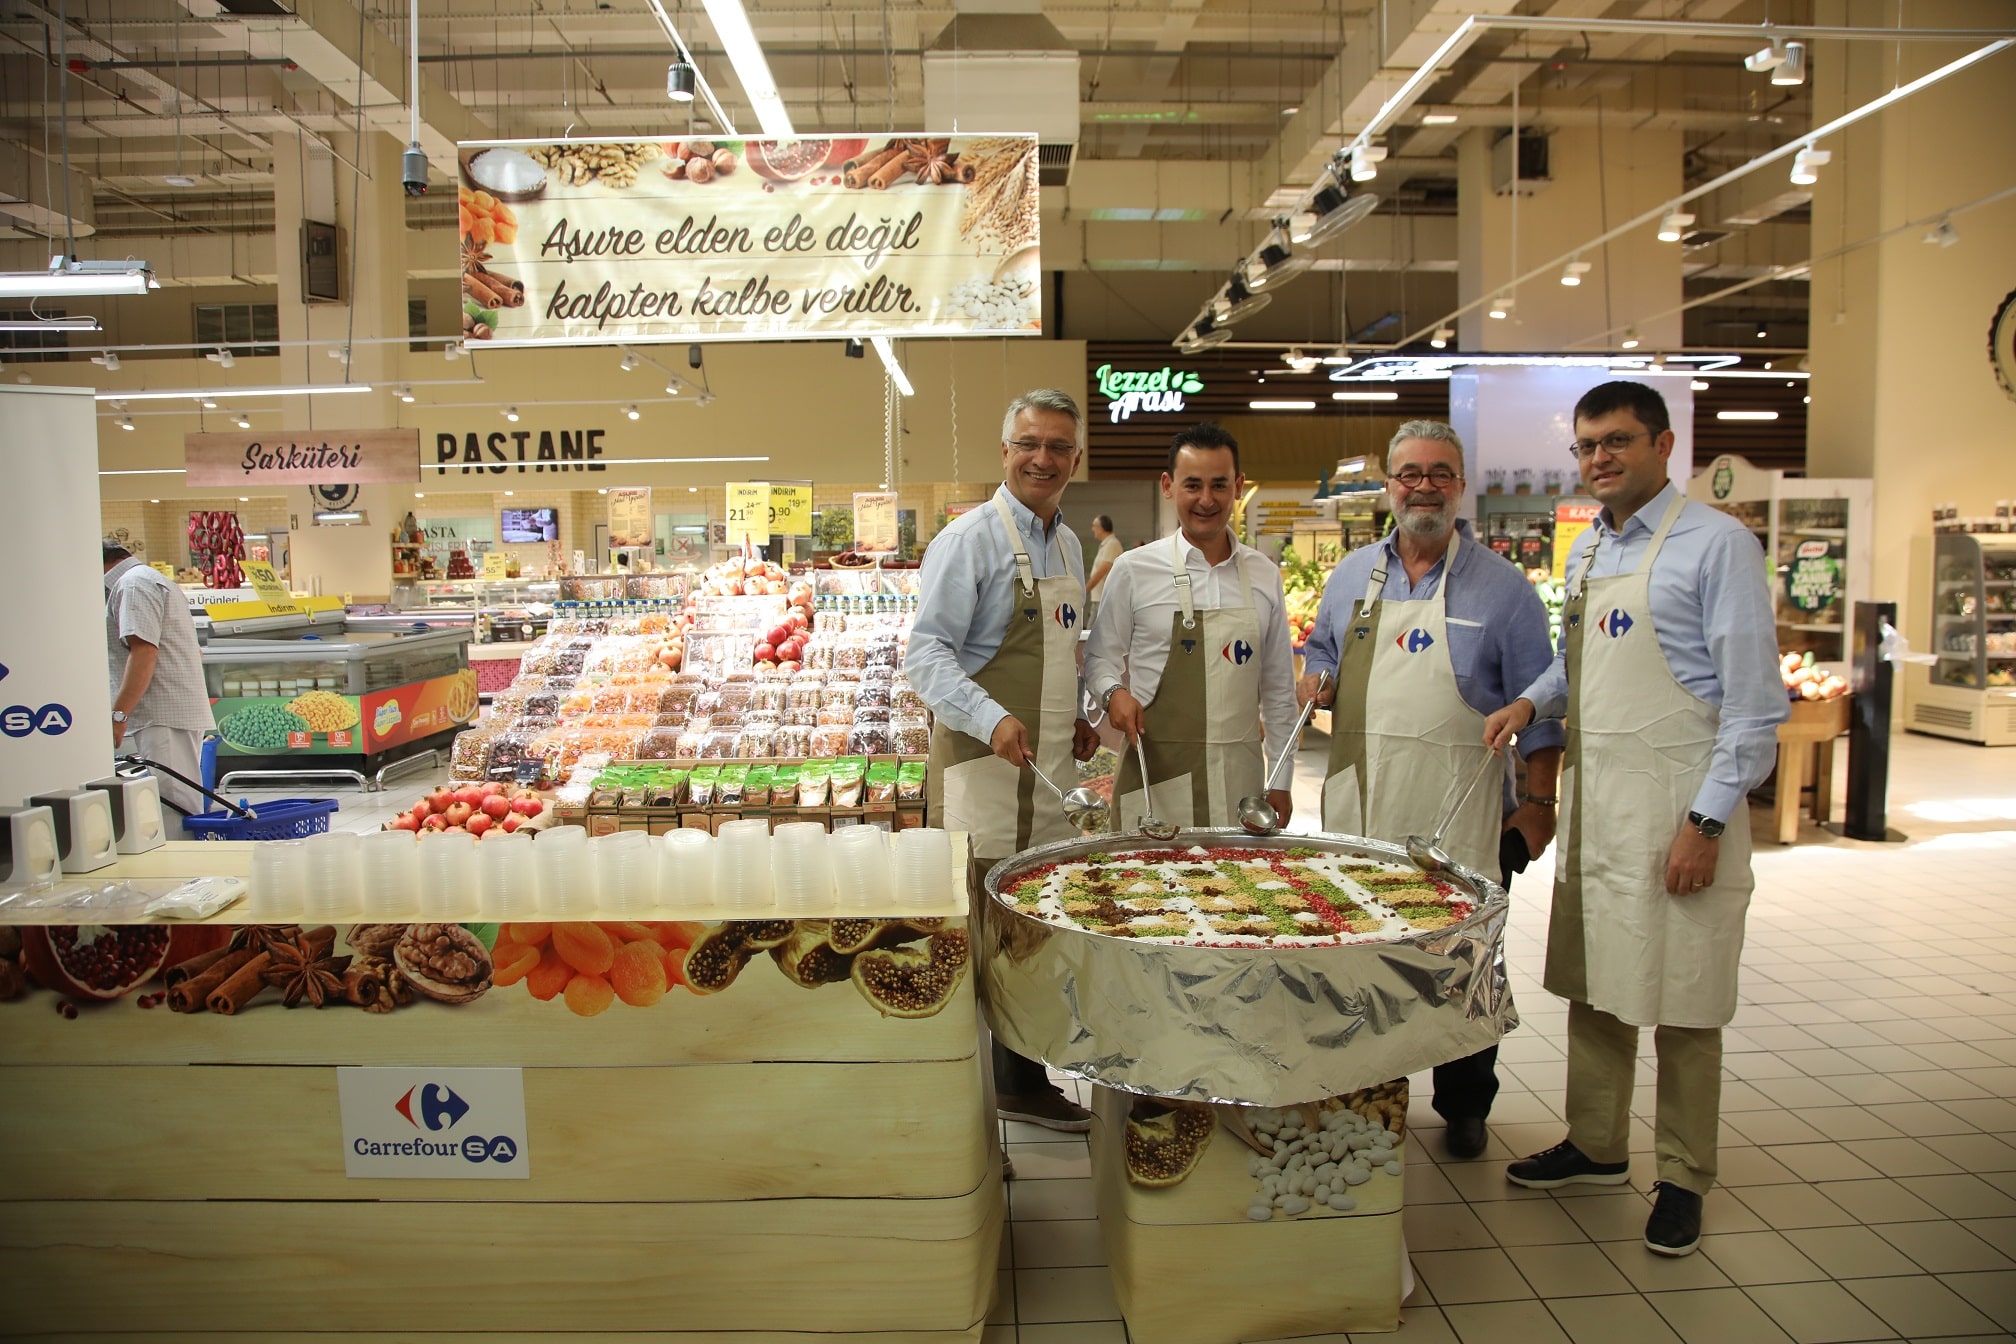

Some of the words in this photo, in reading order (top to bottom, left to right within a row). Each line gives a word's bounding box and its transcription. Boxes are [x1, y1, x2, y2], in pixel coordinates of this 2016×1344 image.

[541, 217, 646, 264] Aşure
[655, 214, 754, 255] elden
[763, 213, 817, 252] ele
[826, 211, 923, 270] değil
[546, 279, 683, 331] kalpten
[691, 275, 792, 317] kalbe
[801, 274, 921, 315] verilir.
[1096, 363, 1171, 400] Lezzet
[1108, 390, 1186, 424] Arası
[241, 442, 363, 475] Şarküteri
[437, 429, 607, 475] PASTANE
[197, 594, 240, 605] Ürünleri
